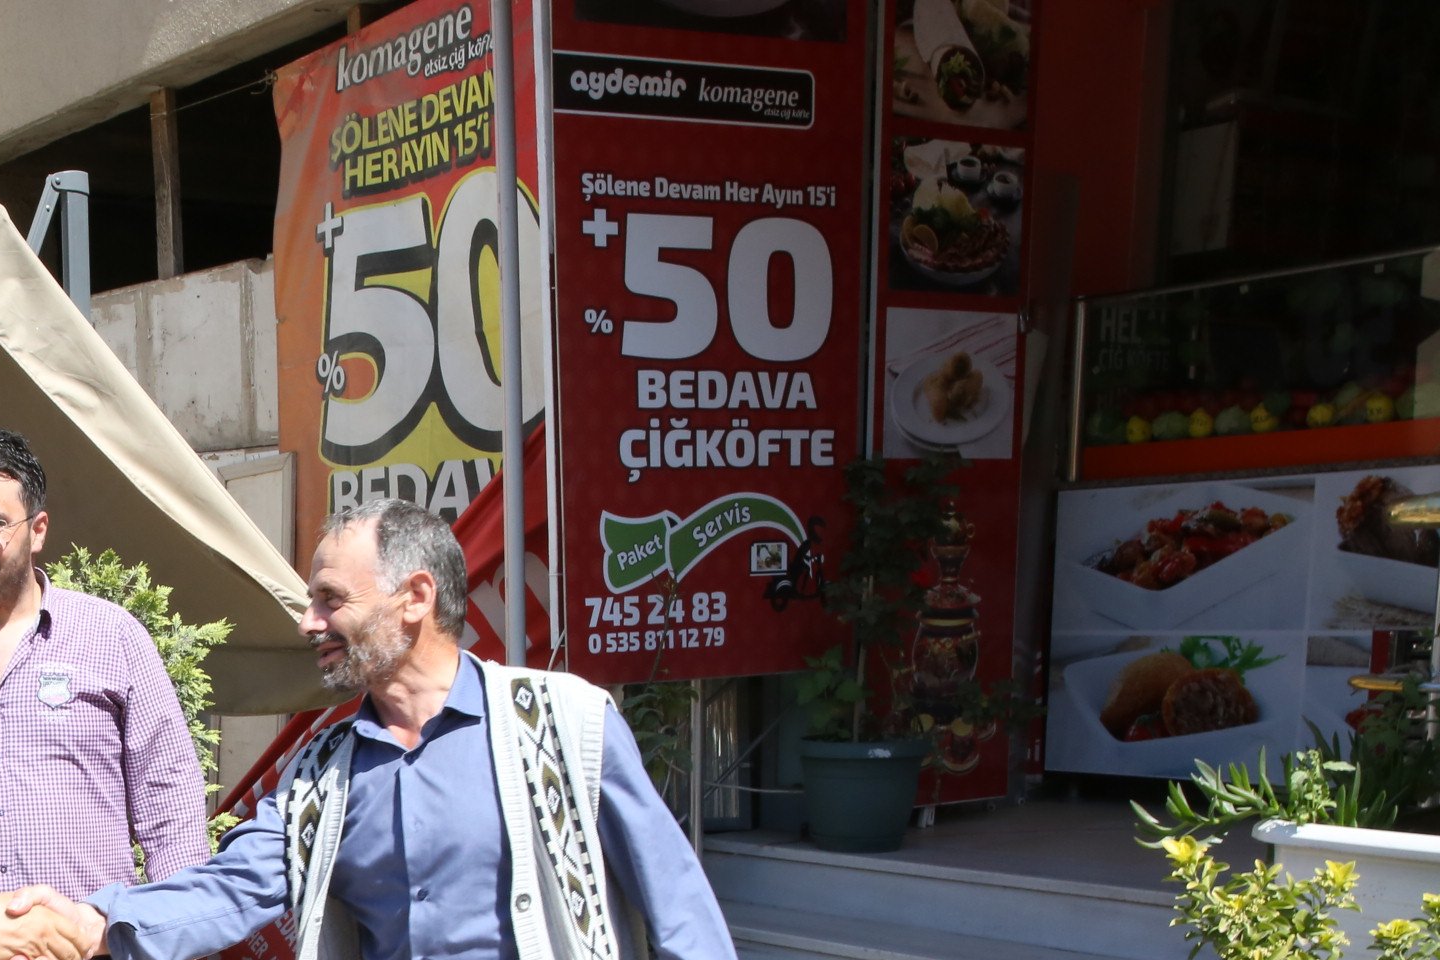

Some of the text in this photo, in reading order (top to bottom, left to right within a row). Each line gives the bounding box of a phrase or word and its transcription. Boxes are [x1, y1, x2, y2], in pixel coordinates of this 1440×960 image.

[337, 6, 472, 91] komagene
[424, 56, 448, 77] etsiz
[448, 45, 466, 70] çiğ
[570, 68, 799, 112] aydemir komagene
[763, 108, 780, 117] etsiz
[791, 109, 810, 119] köfte
[331, 112, 419, 162] ŞÖLENE
[345, 148, 400, 191] HER
[401, 127, 450, 178] AYIN
[581, 172, 836, 209] Şölene Devam Her Ayın 15'i
[621, 213, 834, 362] 50
[637, 369, 818, 409] BEDAVA
[619, 418, 835, 482] ÇİĞKÖFTE
[334, 457, 496, 522] BEDA
[616, 502, 751, 571] Paket Servis
[584, 591, 728, 628] 745 24 83
[588, 633, 602, 654] 0
[606, 632, 640, 653] 535
[678, 628, 700, 649] 12
[703, 626, 726, 647] 79
[245, 931, 269, 960] HER
